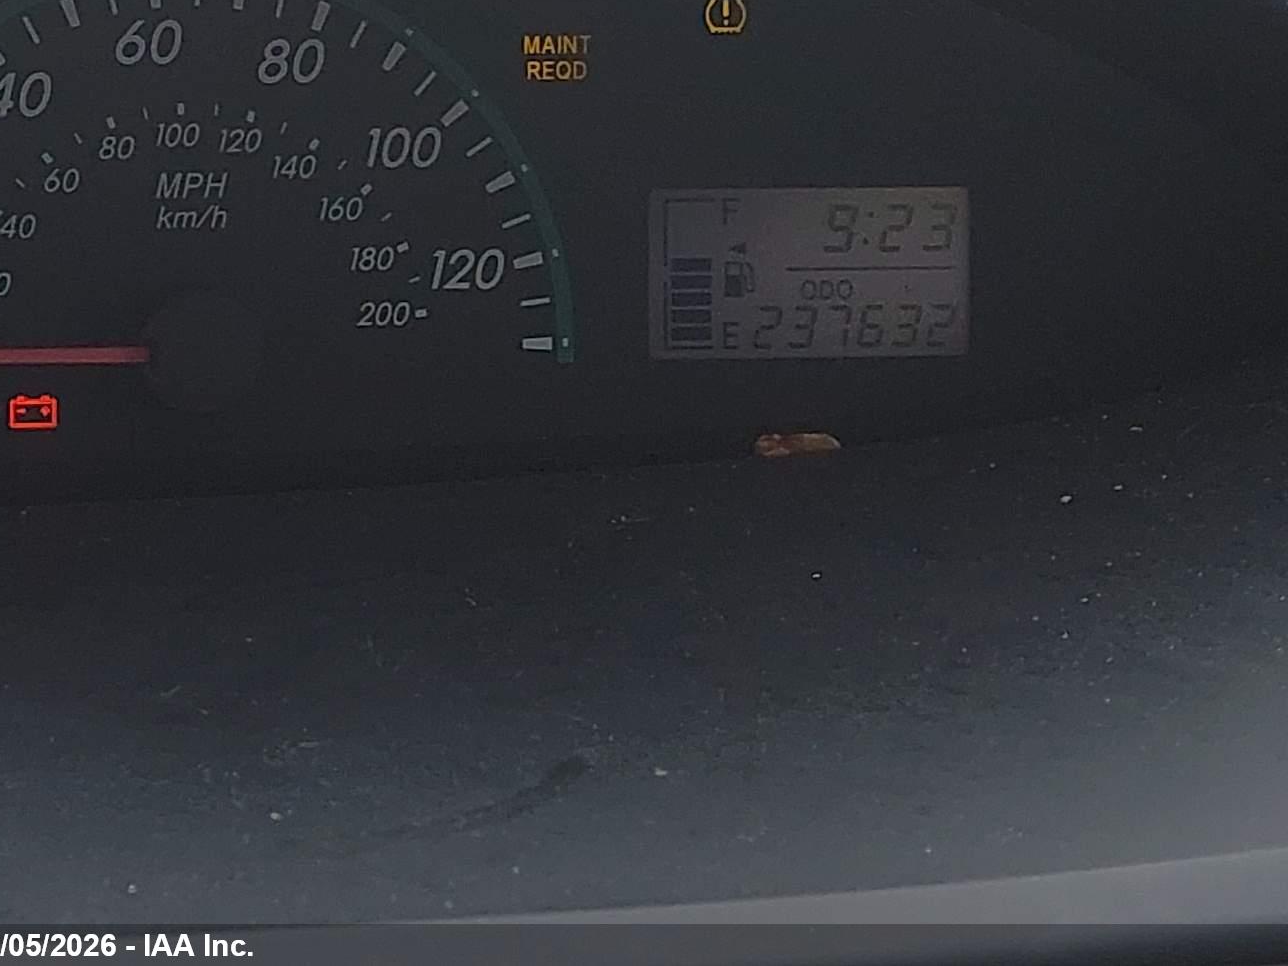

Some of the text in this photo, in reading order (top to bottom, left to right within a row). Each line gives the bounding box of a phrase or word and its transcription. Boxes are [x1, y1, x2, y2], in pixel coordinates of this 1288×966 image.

[115, 19, 184, 66] 60
[523, 33, 591, 57] MAINT
[257, 38, 325, 85] 80
[526, 59, 587, 83] REQD
[98, 135, 135, 160] 80
[155, 123, 200, 148] 100
[219, 127, 262, 153] 120
[366, 126, 442, 170] 100
[273, 154, 316, 180] 140
[44, 168, 79, 194] 60
[156, 173, 227, 199] MPH
[156, 205, 227, 230] km/h
[320, 196, 364, 222] 160
[722, 198, 741, 224] F
[824, 203, 957, 253] 9:23
[351, 245, 394, 271] 180
[429, 248, 504, 291] 120
[357, 303, 409, 327] 200
[753, 304, 956, 350] 237632
[723, 322, 738, 349] E
